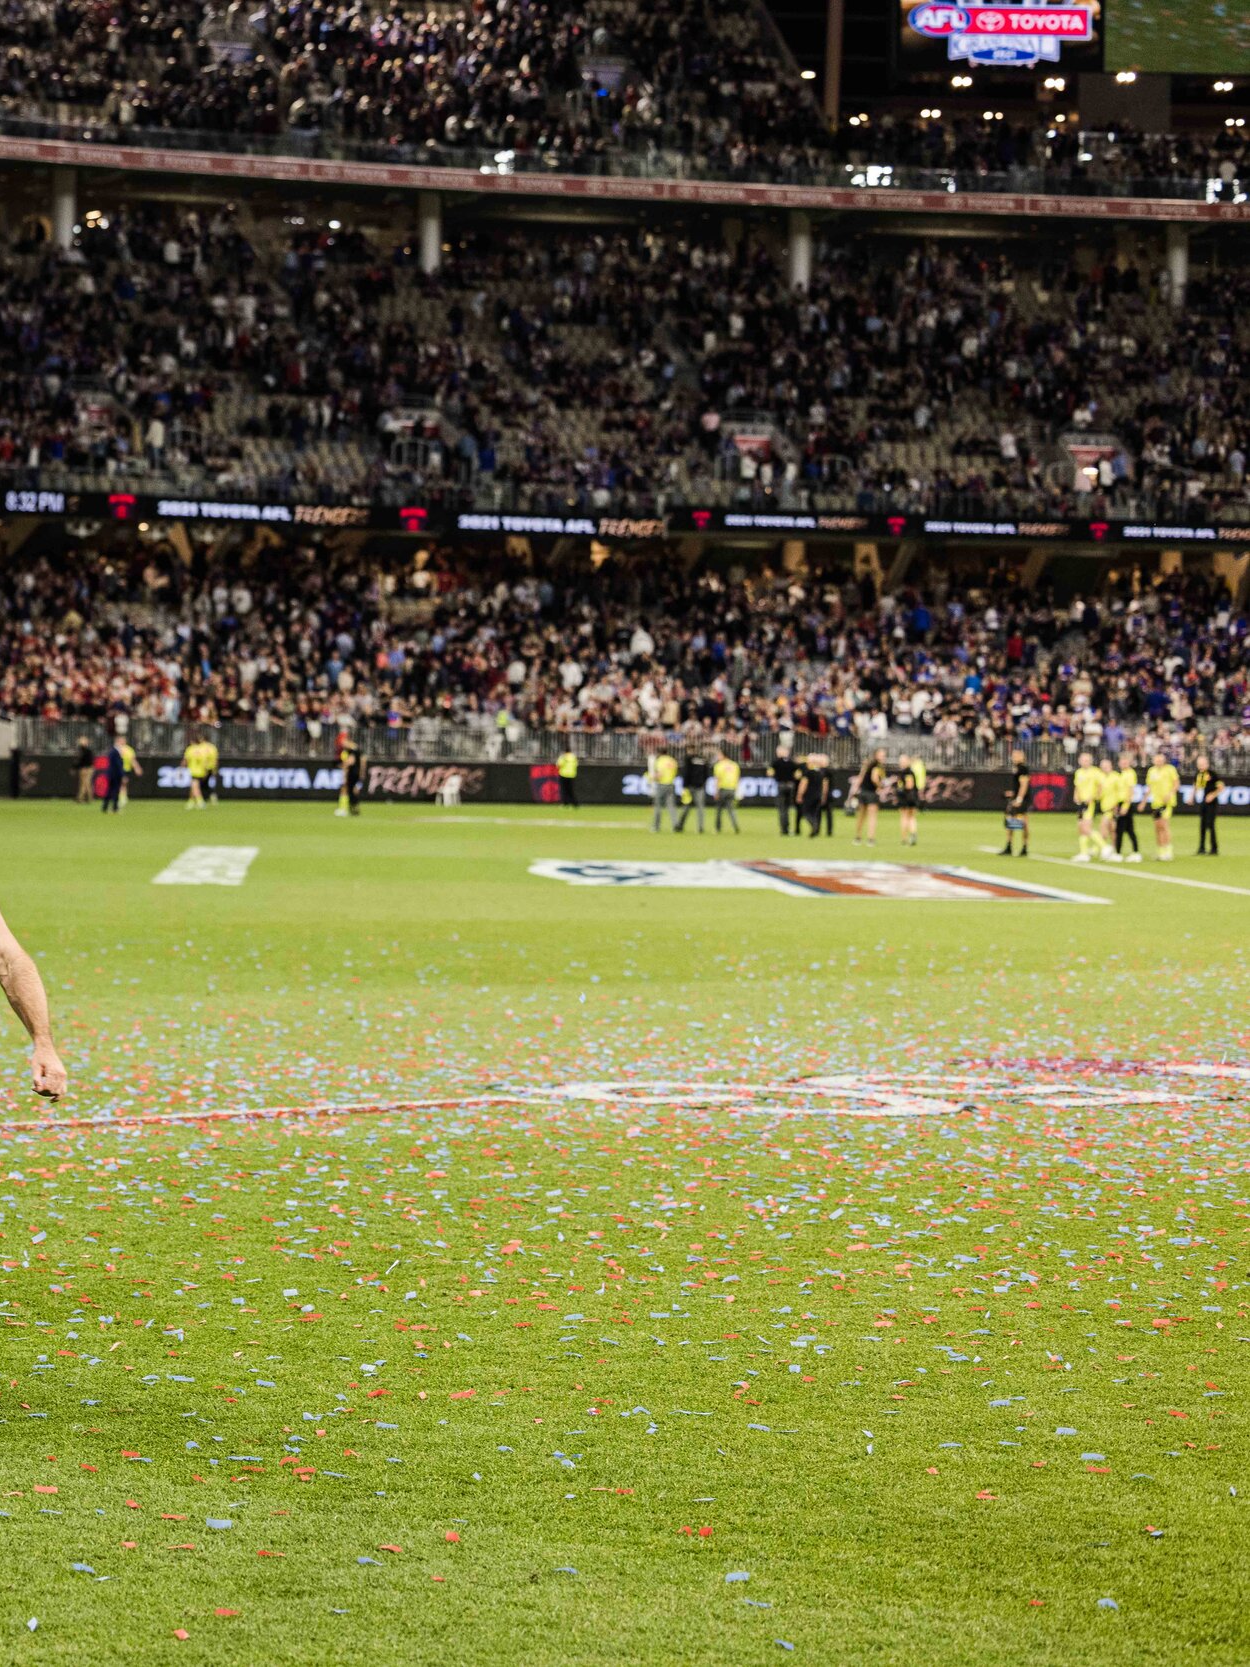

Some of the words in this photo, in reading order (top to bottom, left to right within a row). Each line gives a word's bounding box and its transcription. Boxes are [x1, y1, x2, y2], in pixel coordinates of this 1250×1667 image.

[915, 9, 967, 29] AFL
[1008, 14, 1085, 31] TOYOTA
[200, 502, 261, 520] TOYOTA
[501, 515, 563, 533] TOYOTA
[219, 767, 312, 789] TOYOTA
[313, 768, 344, 789] AF
